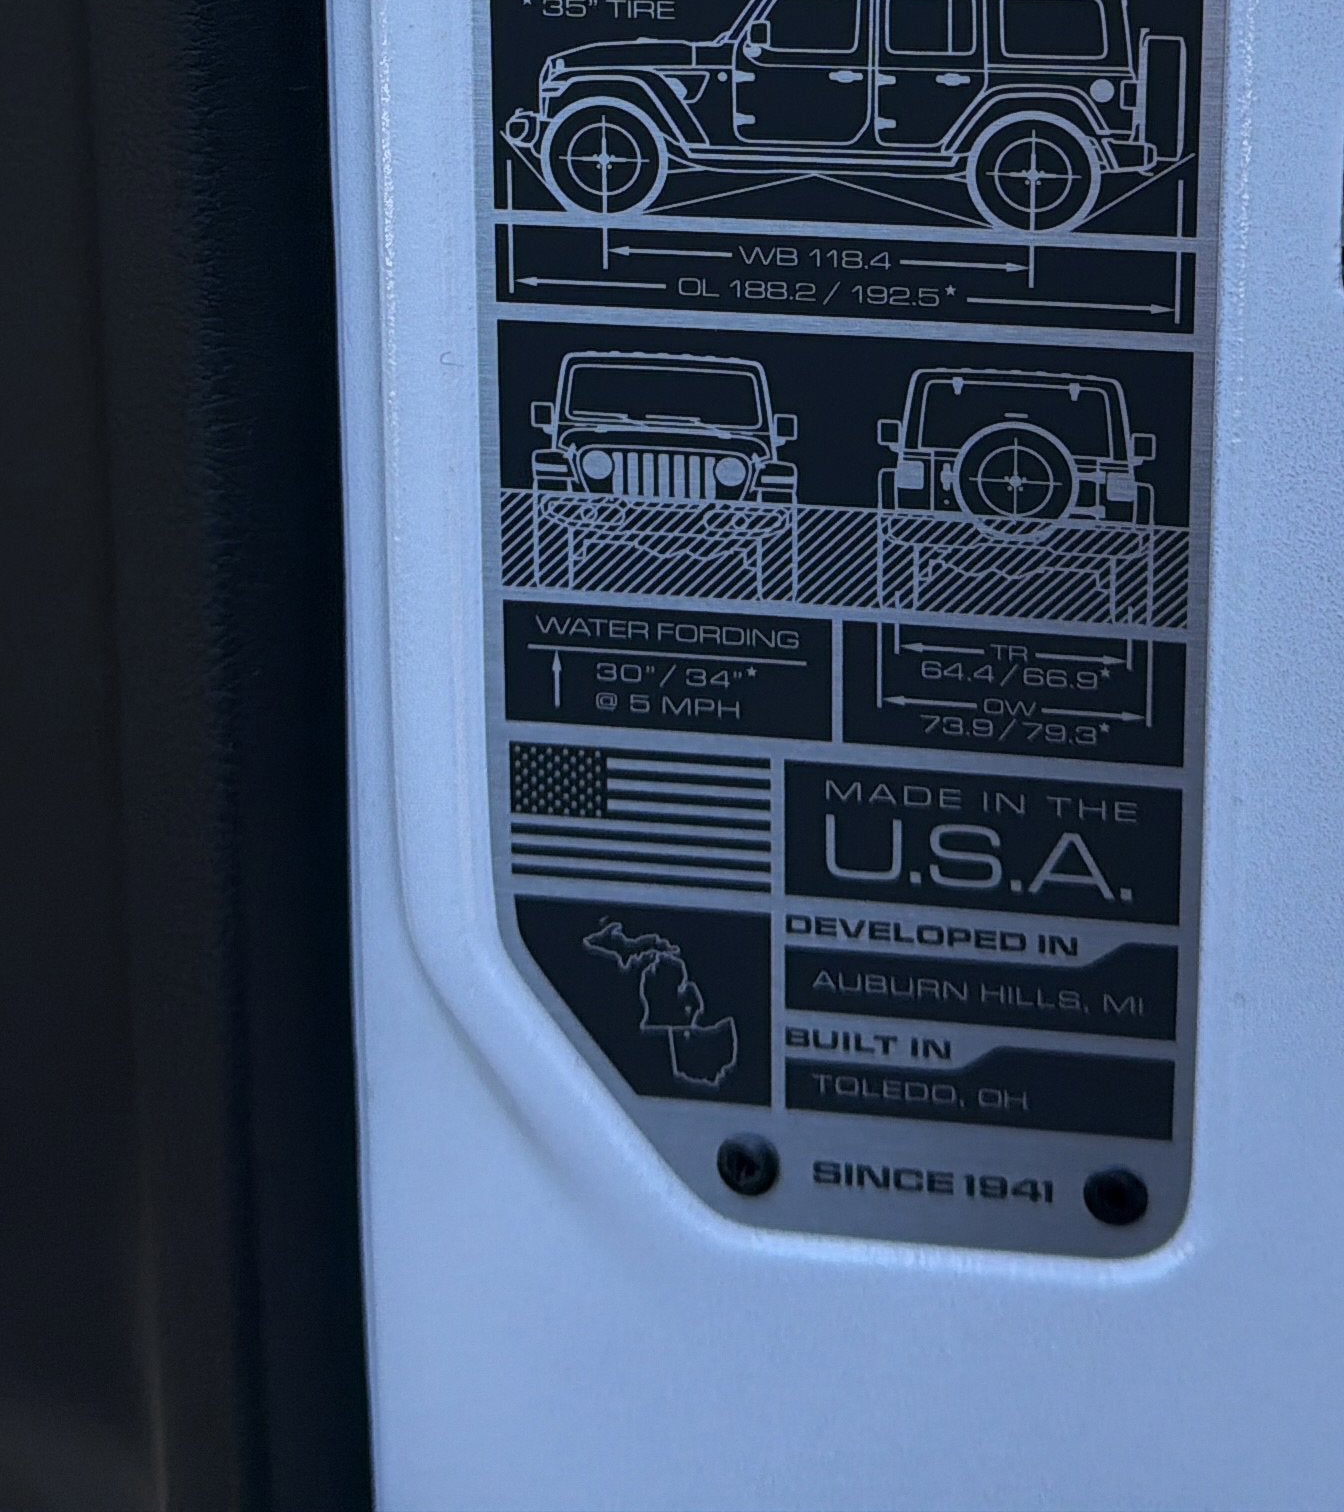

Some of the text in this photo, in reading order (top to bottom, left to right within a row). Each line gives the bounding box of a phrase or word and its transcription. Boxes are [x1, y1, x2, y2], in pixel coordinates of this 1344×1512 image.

[605, 0, 676, 20] TIRE
[738, 245, 892, 270] WB 118.4
[677, 276, 720, 297] OL
[535, 614, 801, 649] WATER FORDING
[989, 643, 1030, 663] TR
[595, 691, 741, 720] @ 5 MPH
[983, 698, 1037, 717] OW
[825, 779, 1139, 823] MADE IN THE
[824, 812, 1134, 903] U.S.A.
[784, 913, 1079, 957] DEVELOPED IN
[811, 969, 1145, 1017] AUBURN HILLS, MI
[784, 1026, 952, 1060] BUILT IN
[811, 1072, 1031, 1111] TOLEDO, OH
[811, 1159, 1054, 1205] SINCE 1941
